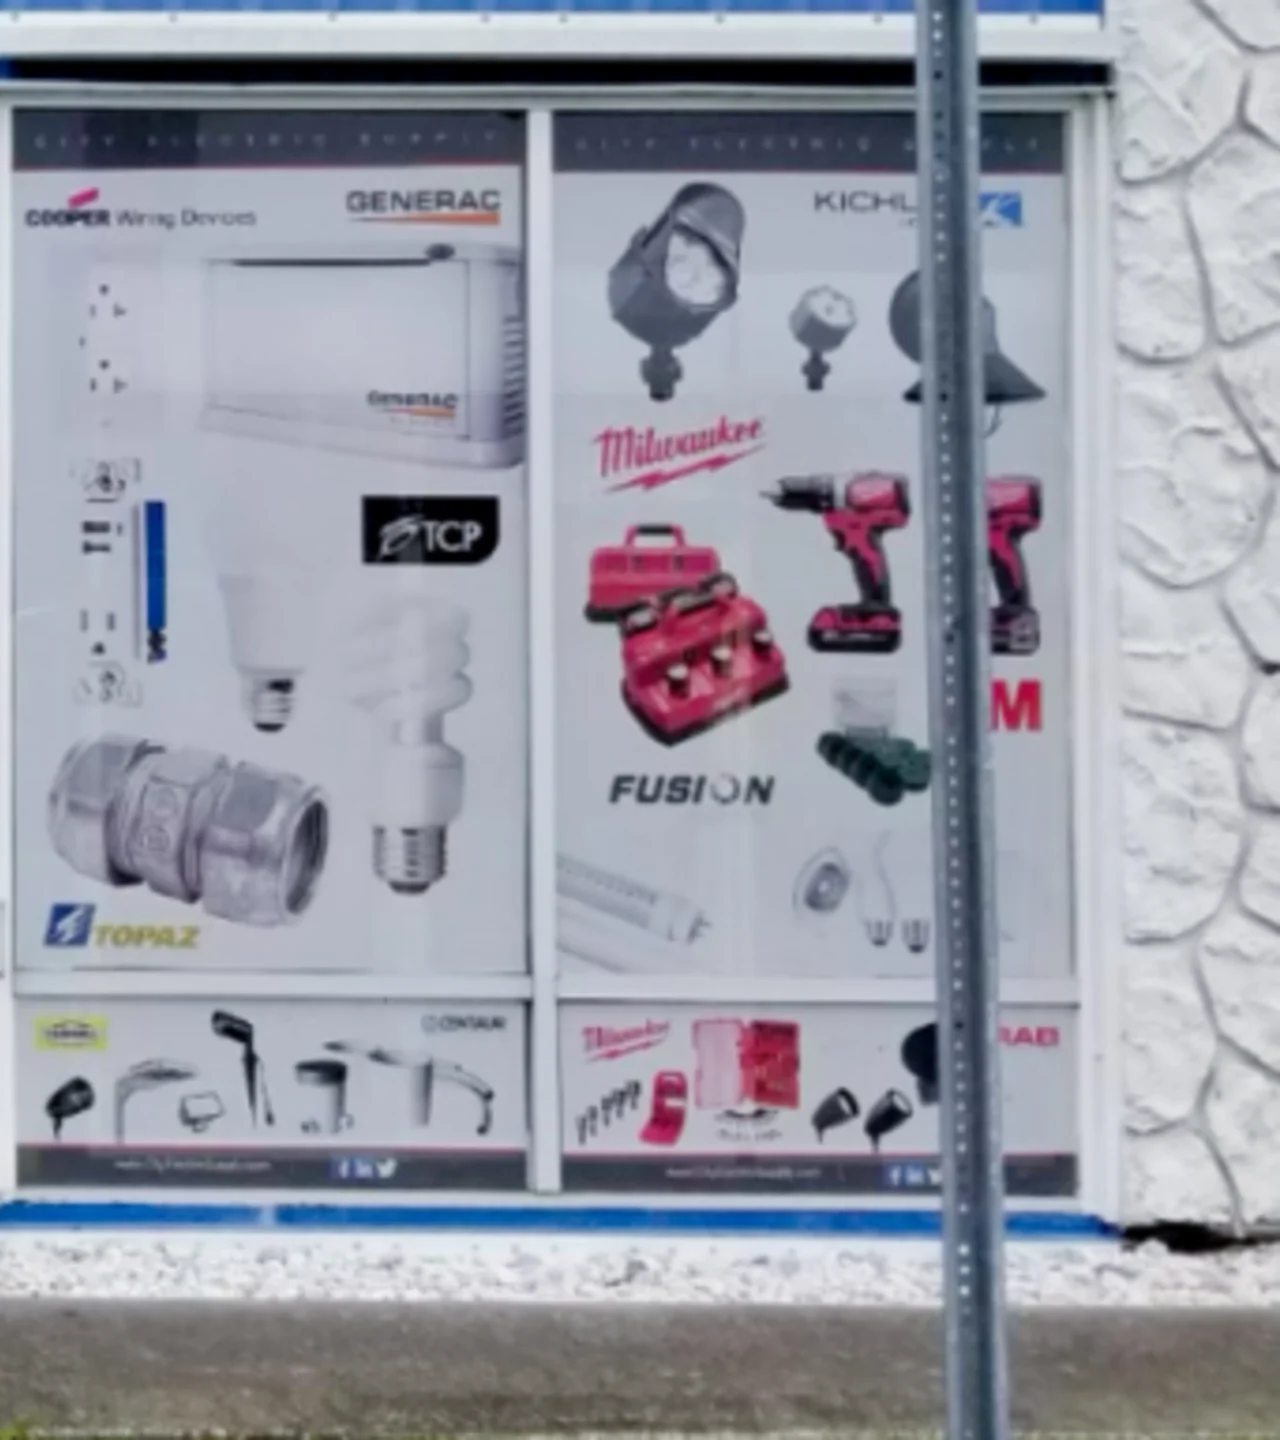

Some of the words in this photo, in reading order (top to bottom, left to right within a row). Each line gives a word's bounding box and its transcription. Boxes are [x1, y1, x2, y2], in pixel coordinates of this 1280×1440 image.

[346, 190, 502, 212] GENERAC
[24, 208, 111, 229] COOPER
[116, 208, 176, 230] Wiring
[181, 208, 257, 227] Devices
[592, 415, 765, 478] Milwaukee
[423, 521, 482, 552] TCP
[609, 774, 776, 805] FUSION
[94, 925, 200, 948] TOPAZ
